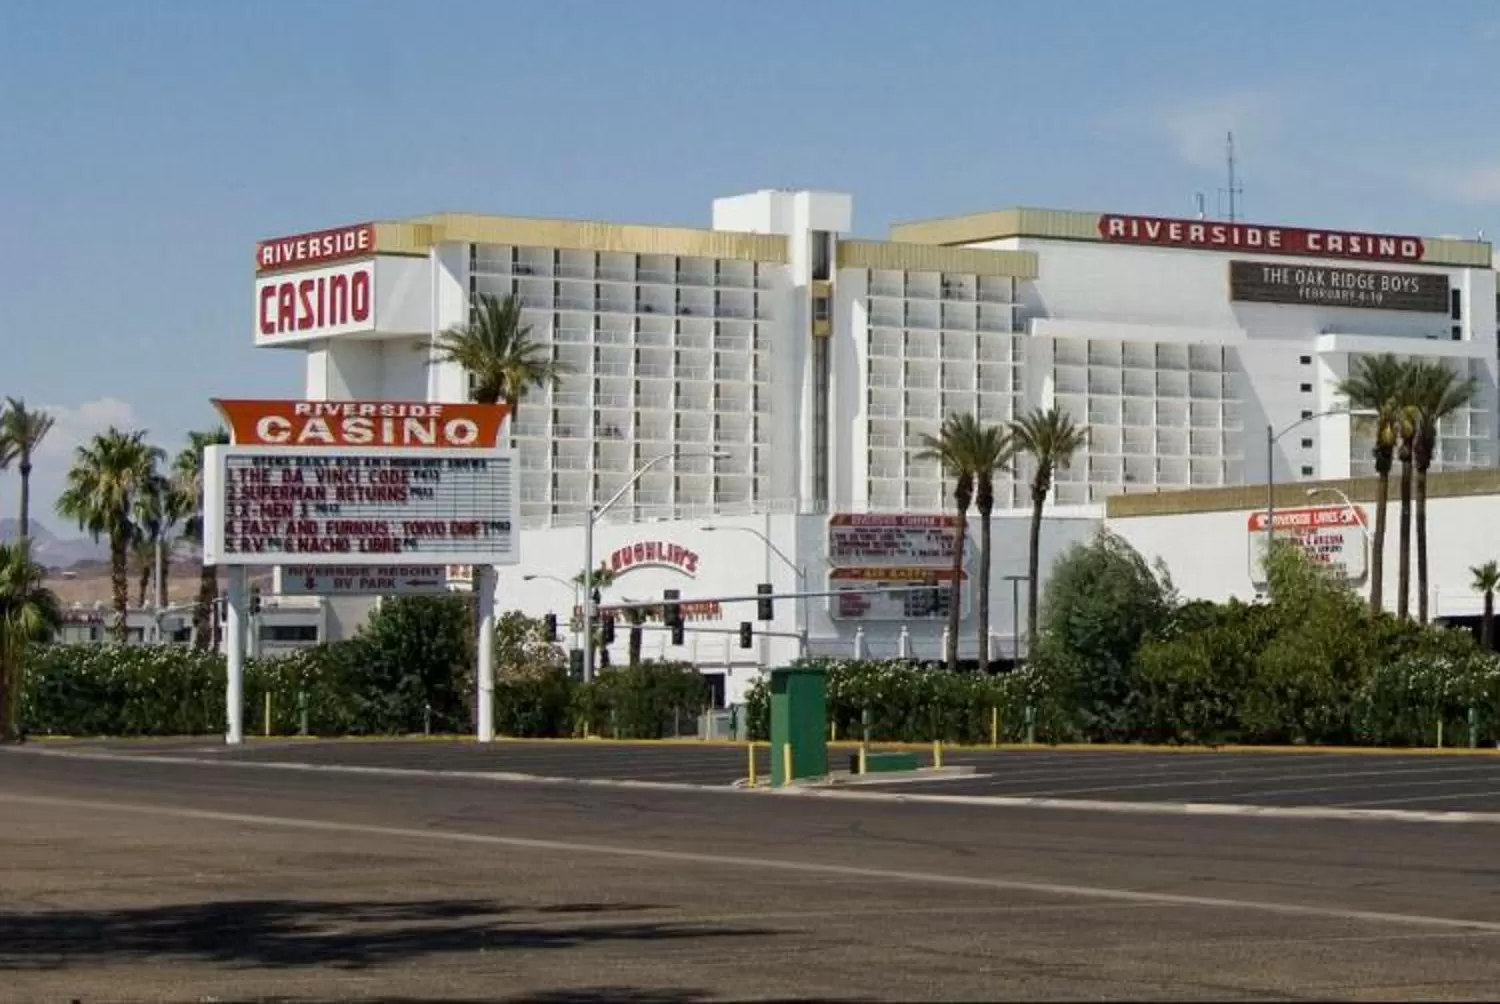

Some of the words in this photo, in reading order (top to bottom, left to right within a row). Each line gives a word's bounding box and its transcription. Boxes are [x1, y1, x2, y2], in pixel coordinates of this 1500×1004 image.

[1109, 218, 1281, 248] RIVERSIDE
[1307, 232, 1417, 258] CASINO
[263, 229, 369, 265] RIVERSIDE
[1263, 267, 1290, 285] THE
[1295, 269, 1325, 287] OAK
[1331, 271, 1377, 290] RIDGE
[1381, 275, 1420, 294] BOYS
[259, 269, 369, 335] CASINO
[294, 402, 444, 417] RIVERSIDE
[256, 415, 480, 445] CASINO
[282, 467, 303, 483] DA
[316, 468, 359, 484] VINCI
[368, 468, 410, 485] CODE
[336, 485, 409, 502] RETURNS
[286, 519, 319, 536] AND
[358, 537, 402, 553] LIBRE
[378, 566, 441, 577] RESORT
[333, 577, 352, 589] RV
[358, 577, 397, 589] PARK
